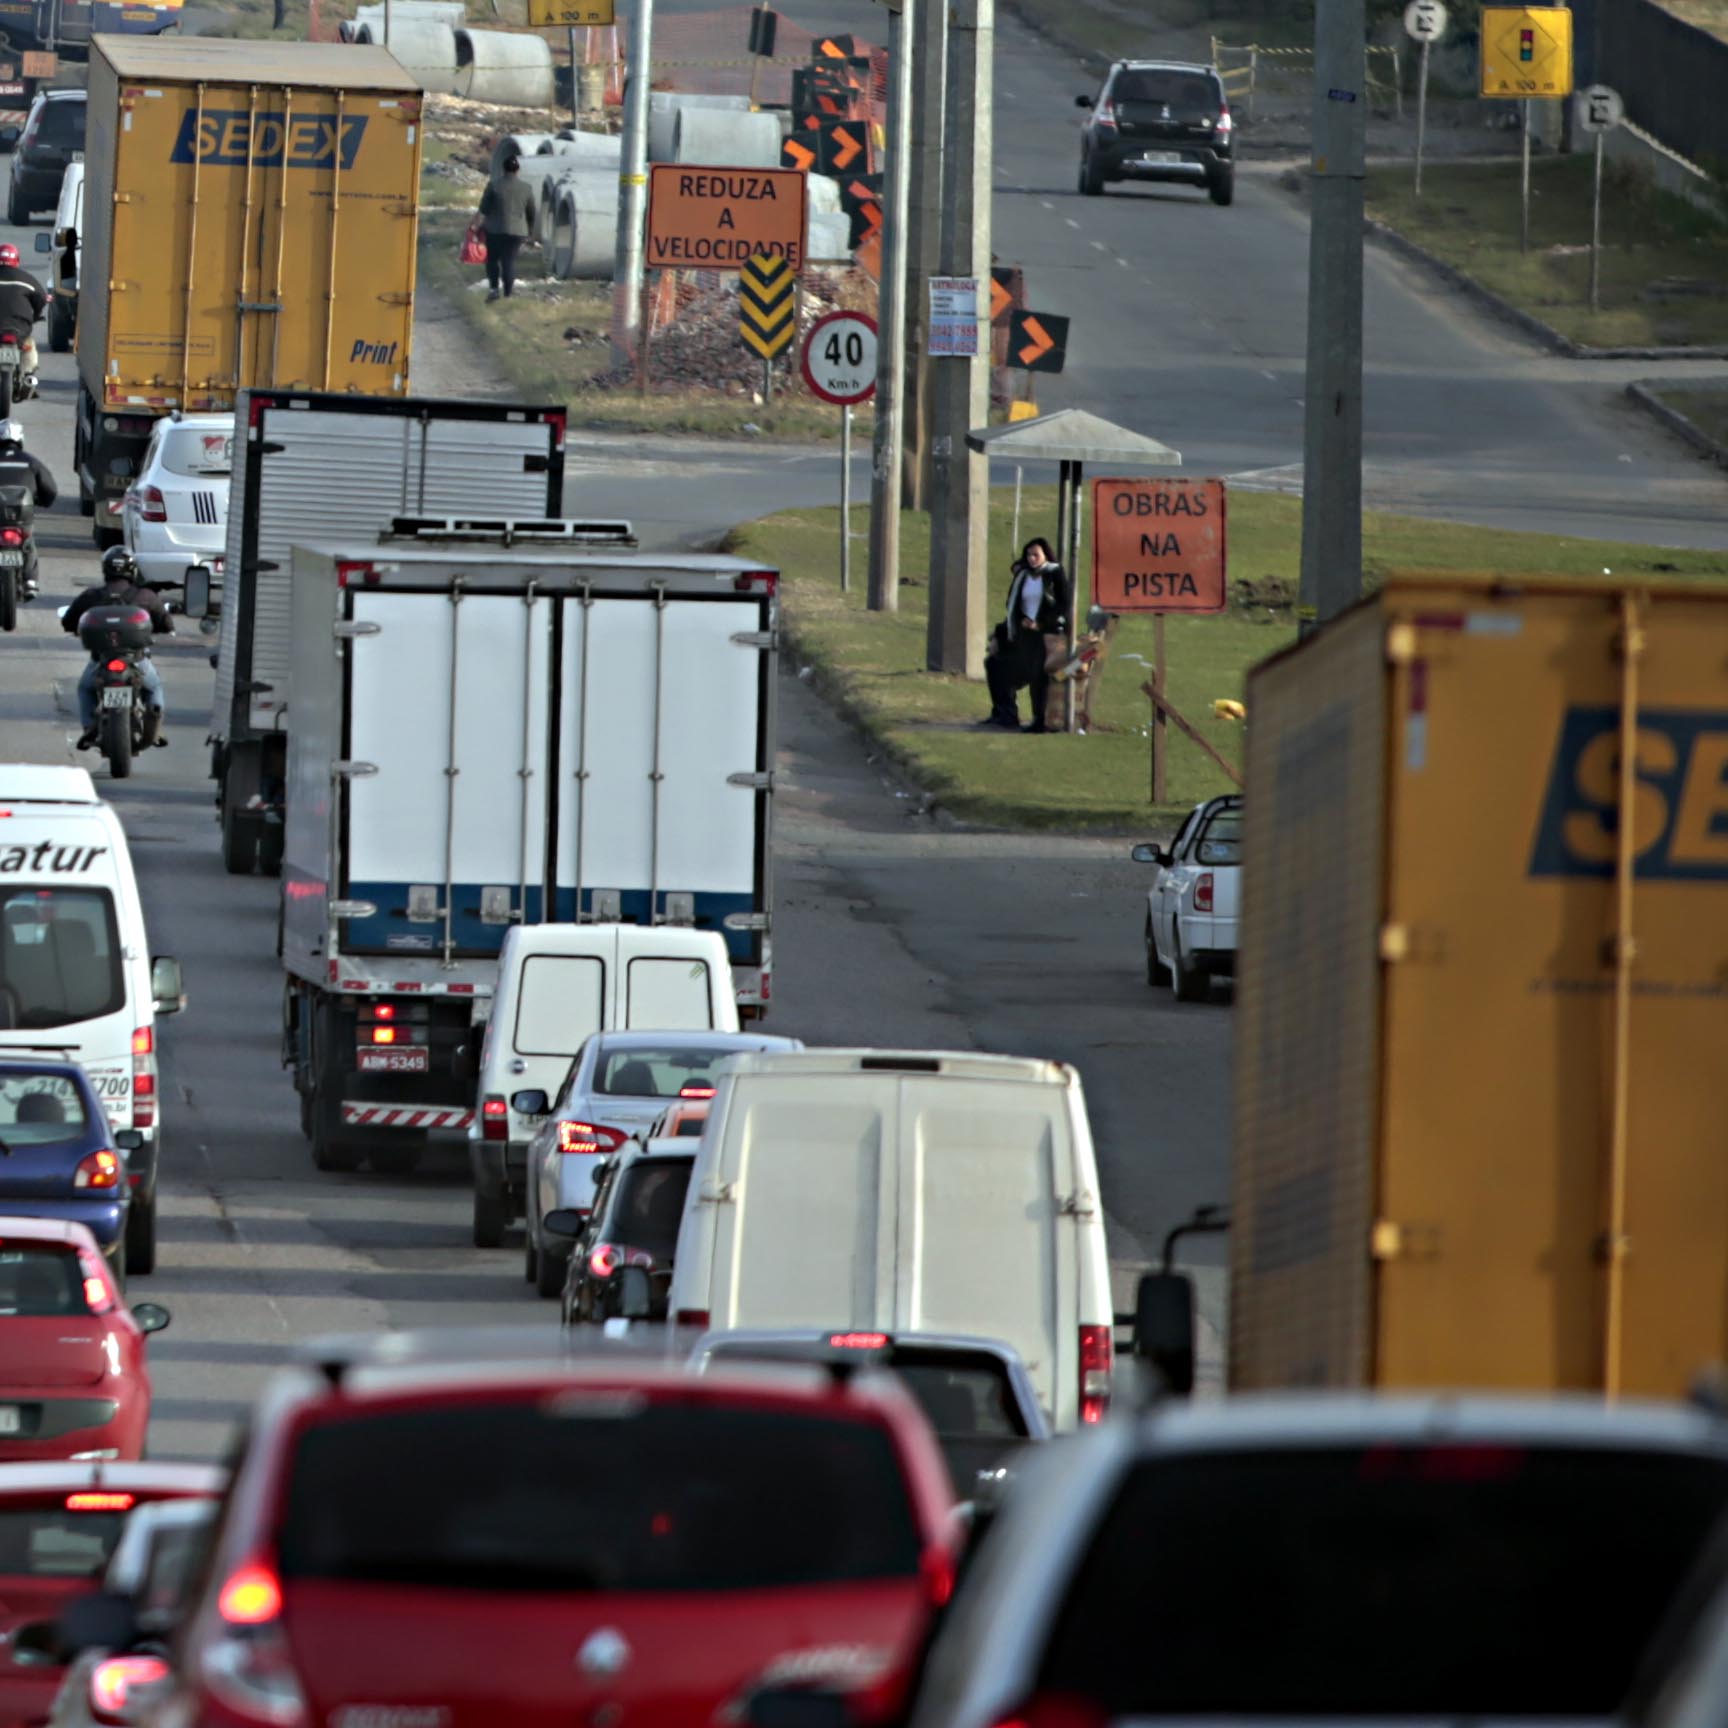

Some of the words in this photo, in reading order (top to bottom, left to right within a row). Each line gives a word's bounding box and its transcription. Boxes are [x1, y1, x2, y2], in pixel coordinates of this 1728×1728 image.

[560, 11, 580, 22] 100
[587, 12, 600, 21] m
[1516, 80, 1536, 90] 100
[187, 117, 354, 161] SEDEX
[680, 176, 776, 200] REDUZA
[717, 208, 735, 229] A
[654, 237, 798, 262] VELOCIDADE
[350, 339, 397, 365] Print
[825, 332, 863, 367] 40
[1113, 492, 1207, 517] OBRAS
[1140, 533, 1181, 557] NA
[1124, 572, 1198, 597] PISTA
